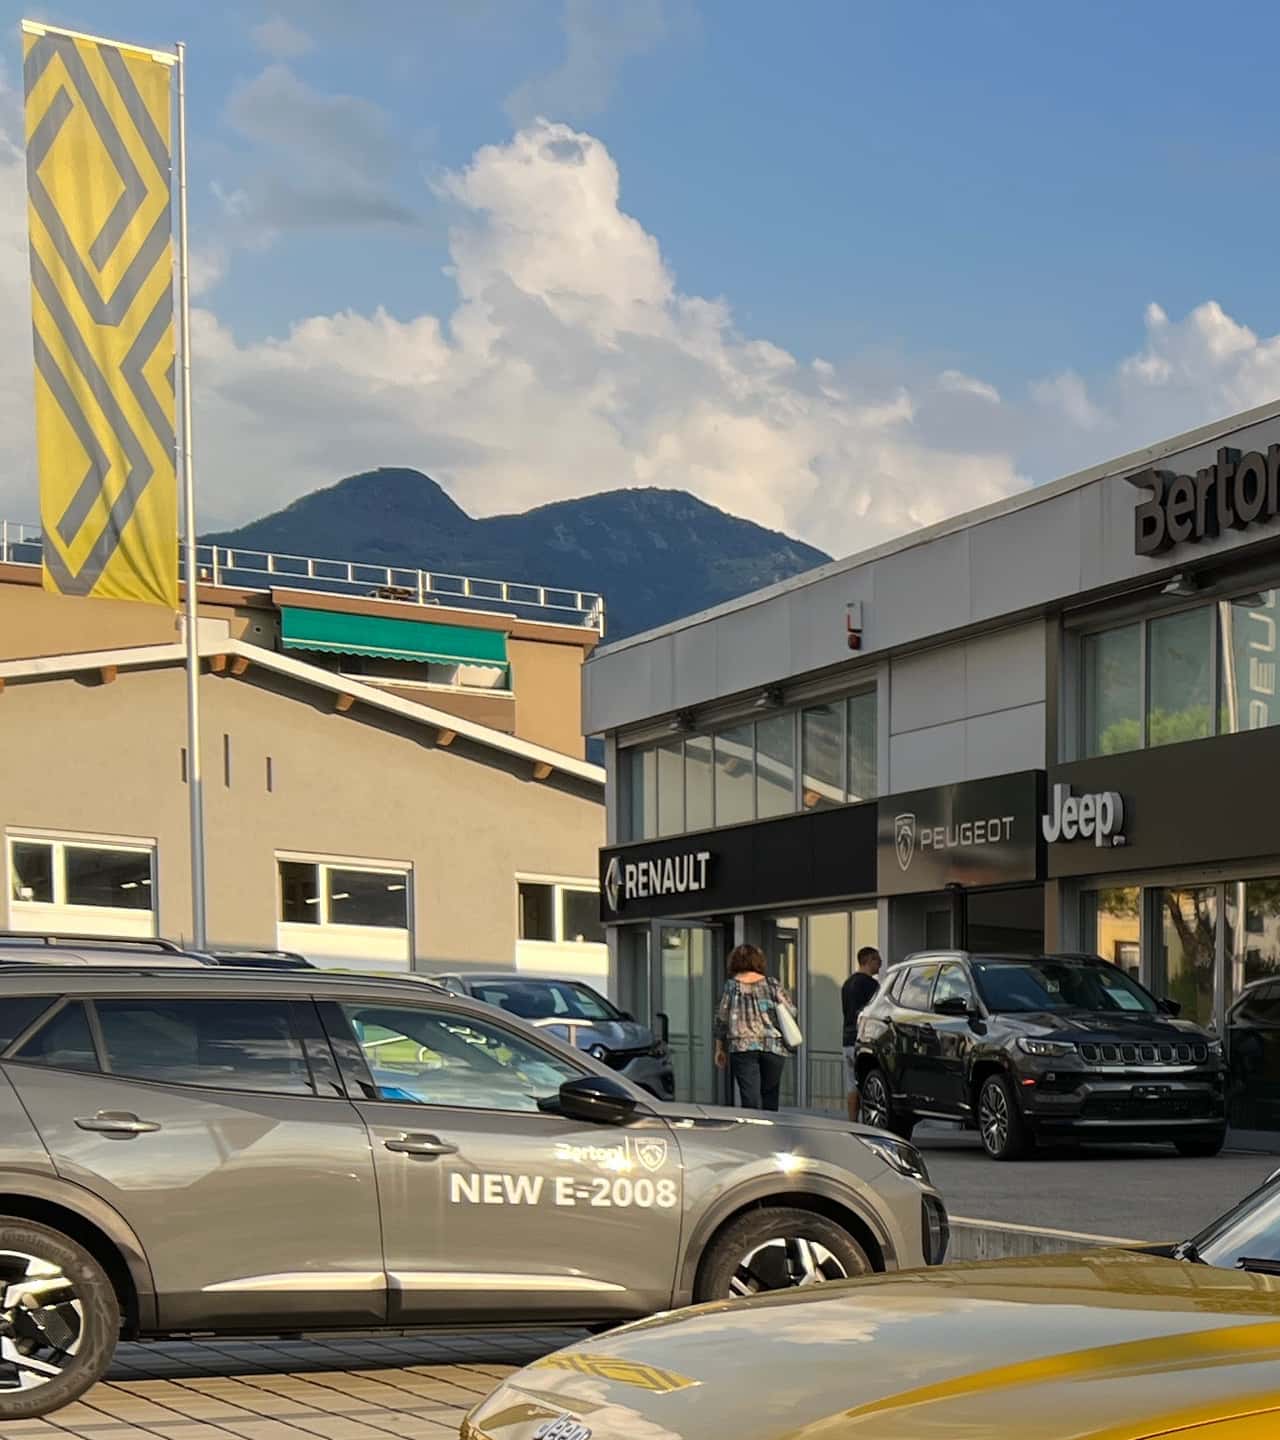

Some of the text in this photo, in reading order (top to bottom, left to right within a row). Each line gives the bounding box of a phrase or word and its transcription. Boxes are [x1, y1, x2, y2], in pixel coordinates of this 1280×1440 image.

[920, 816, 1014, 849] PEUGEOT
[1042, 783, 1124, 848] Jeep
[625, 851, 710, 899] RENAULT
[450, 1173, 677, 1208] NEW E-2008
